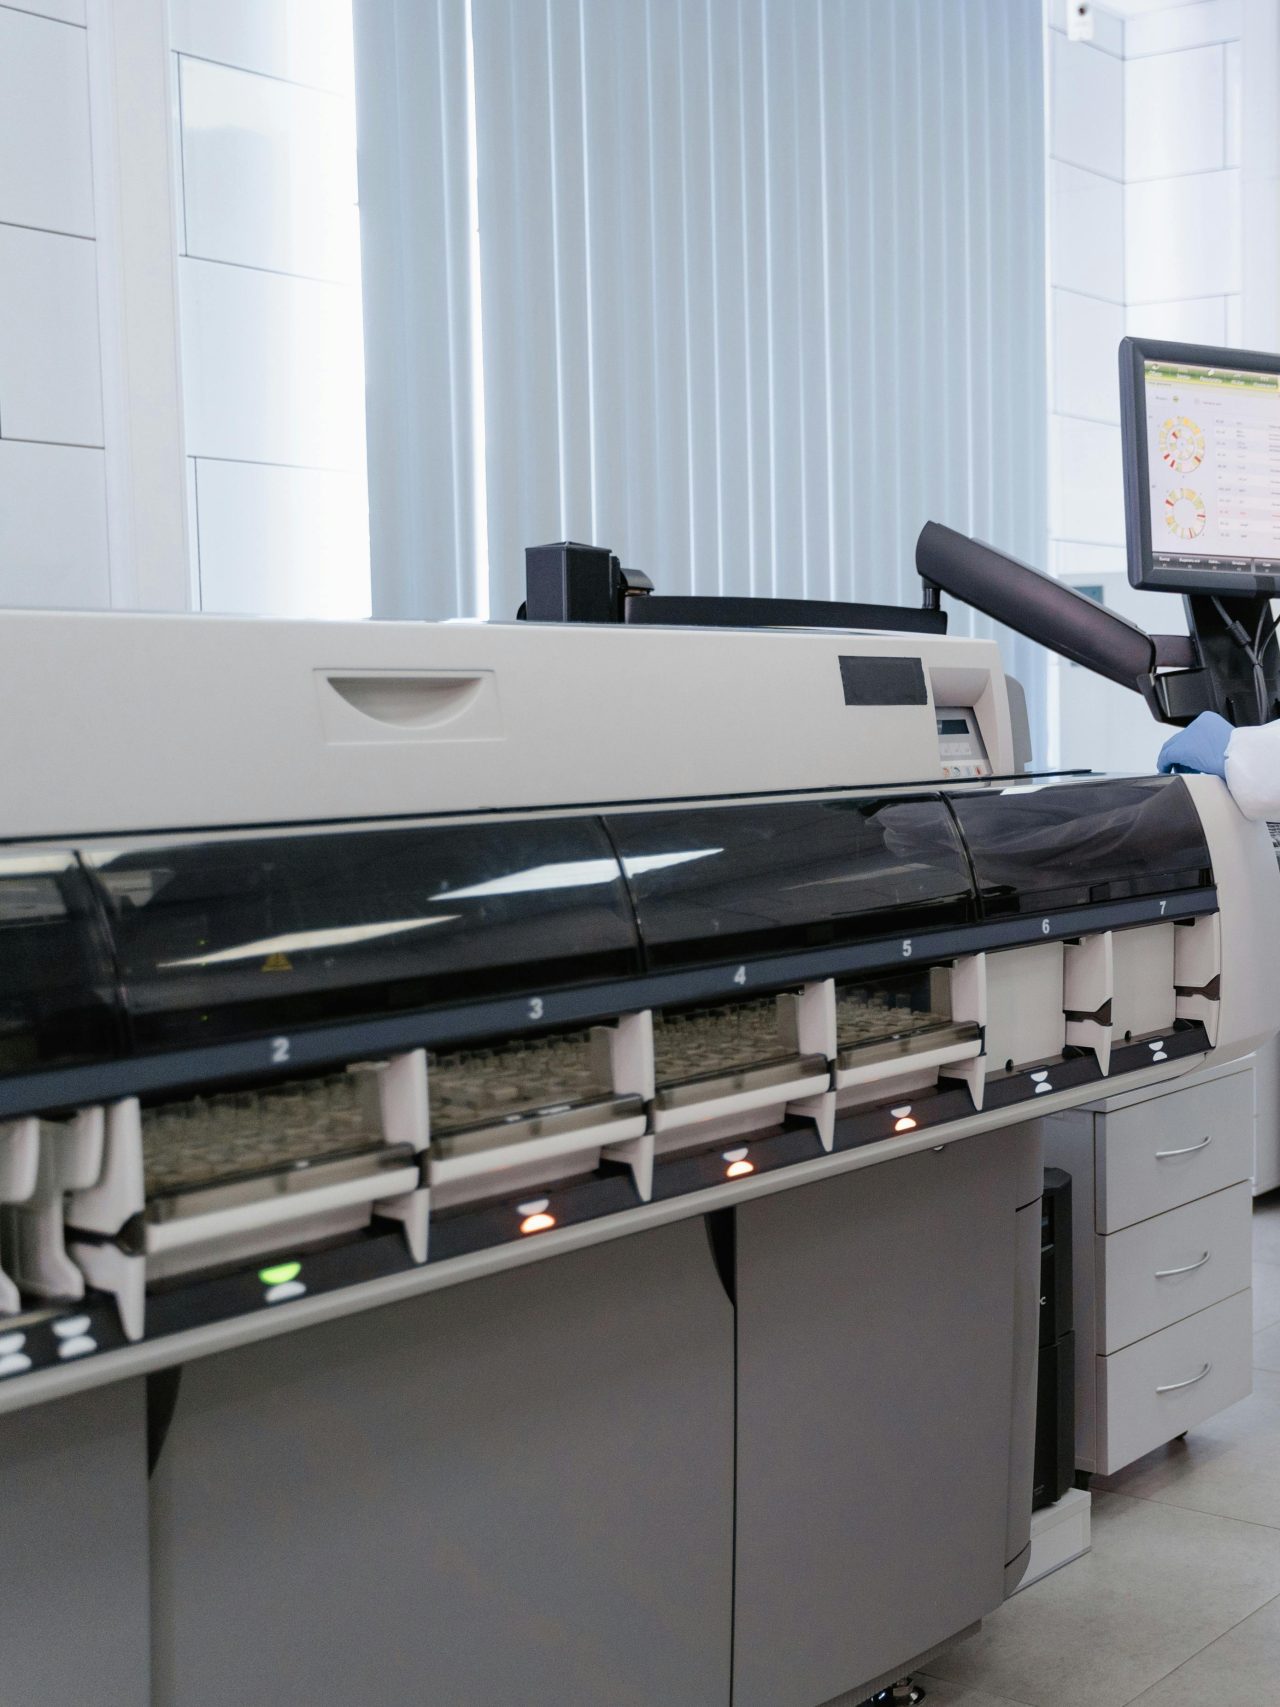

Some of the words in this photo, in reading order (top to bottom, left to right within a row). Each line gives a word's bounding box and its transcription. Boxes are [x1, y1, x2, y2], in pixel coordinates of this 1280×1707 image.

[1158, 900, 1167, 915] 7
[1041, 918, 1051, 934] 6
[902, 939, 913, 957] 5
[732, 965, 748, 986] 4
[527, 997, 545, 1021] 3
[270, 1036, 291, 1064] 2
